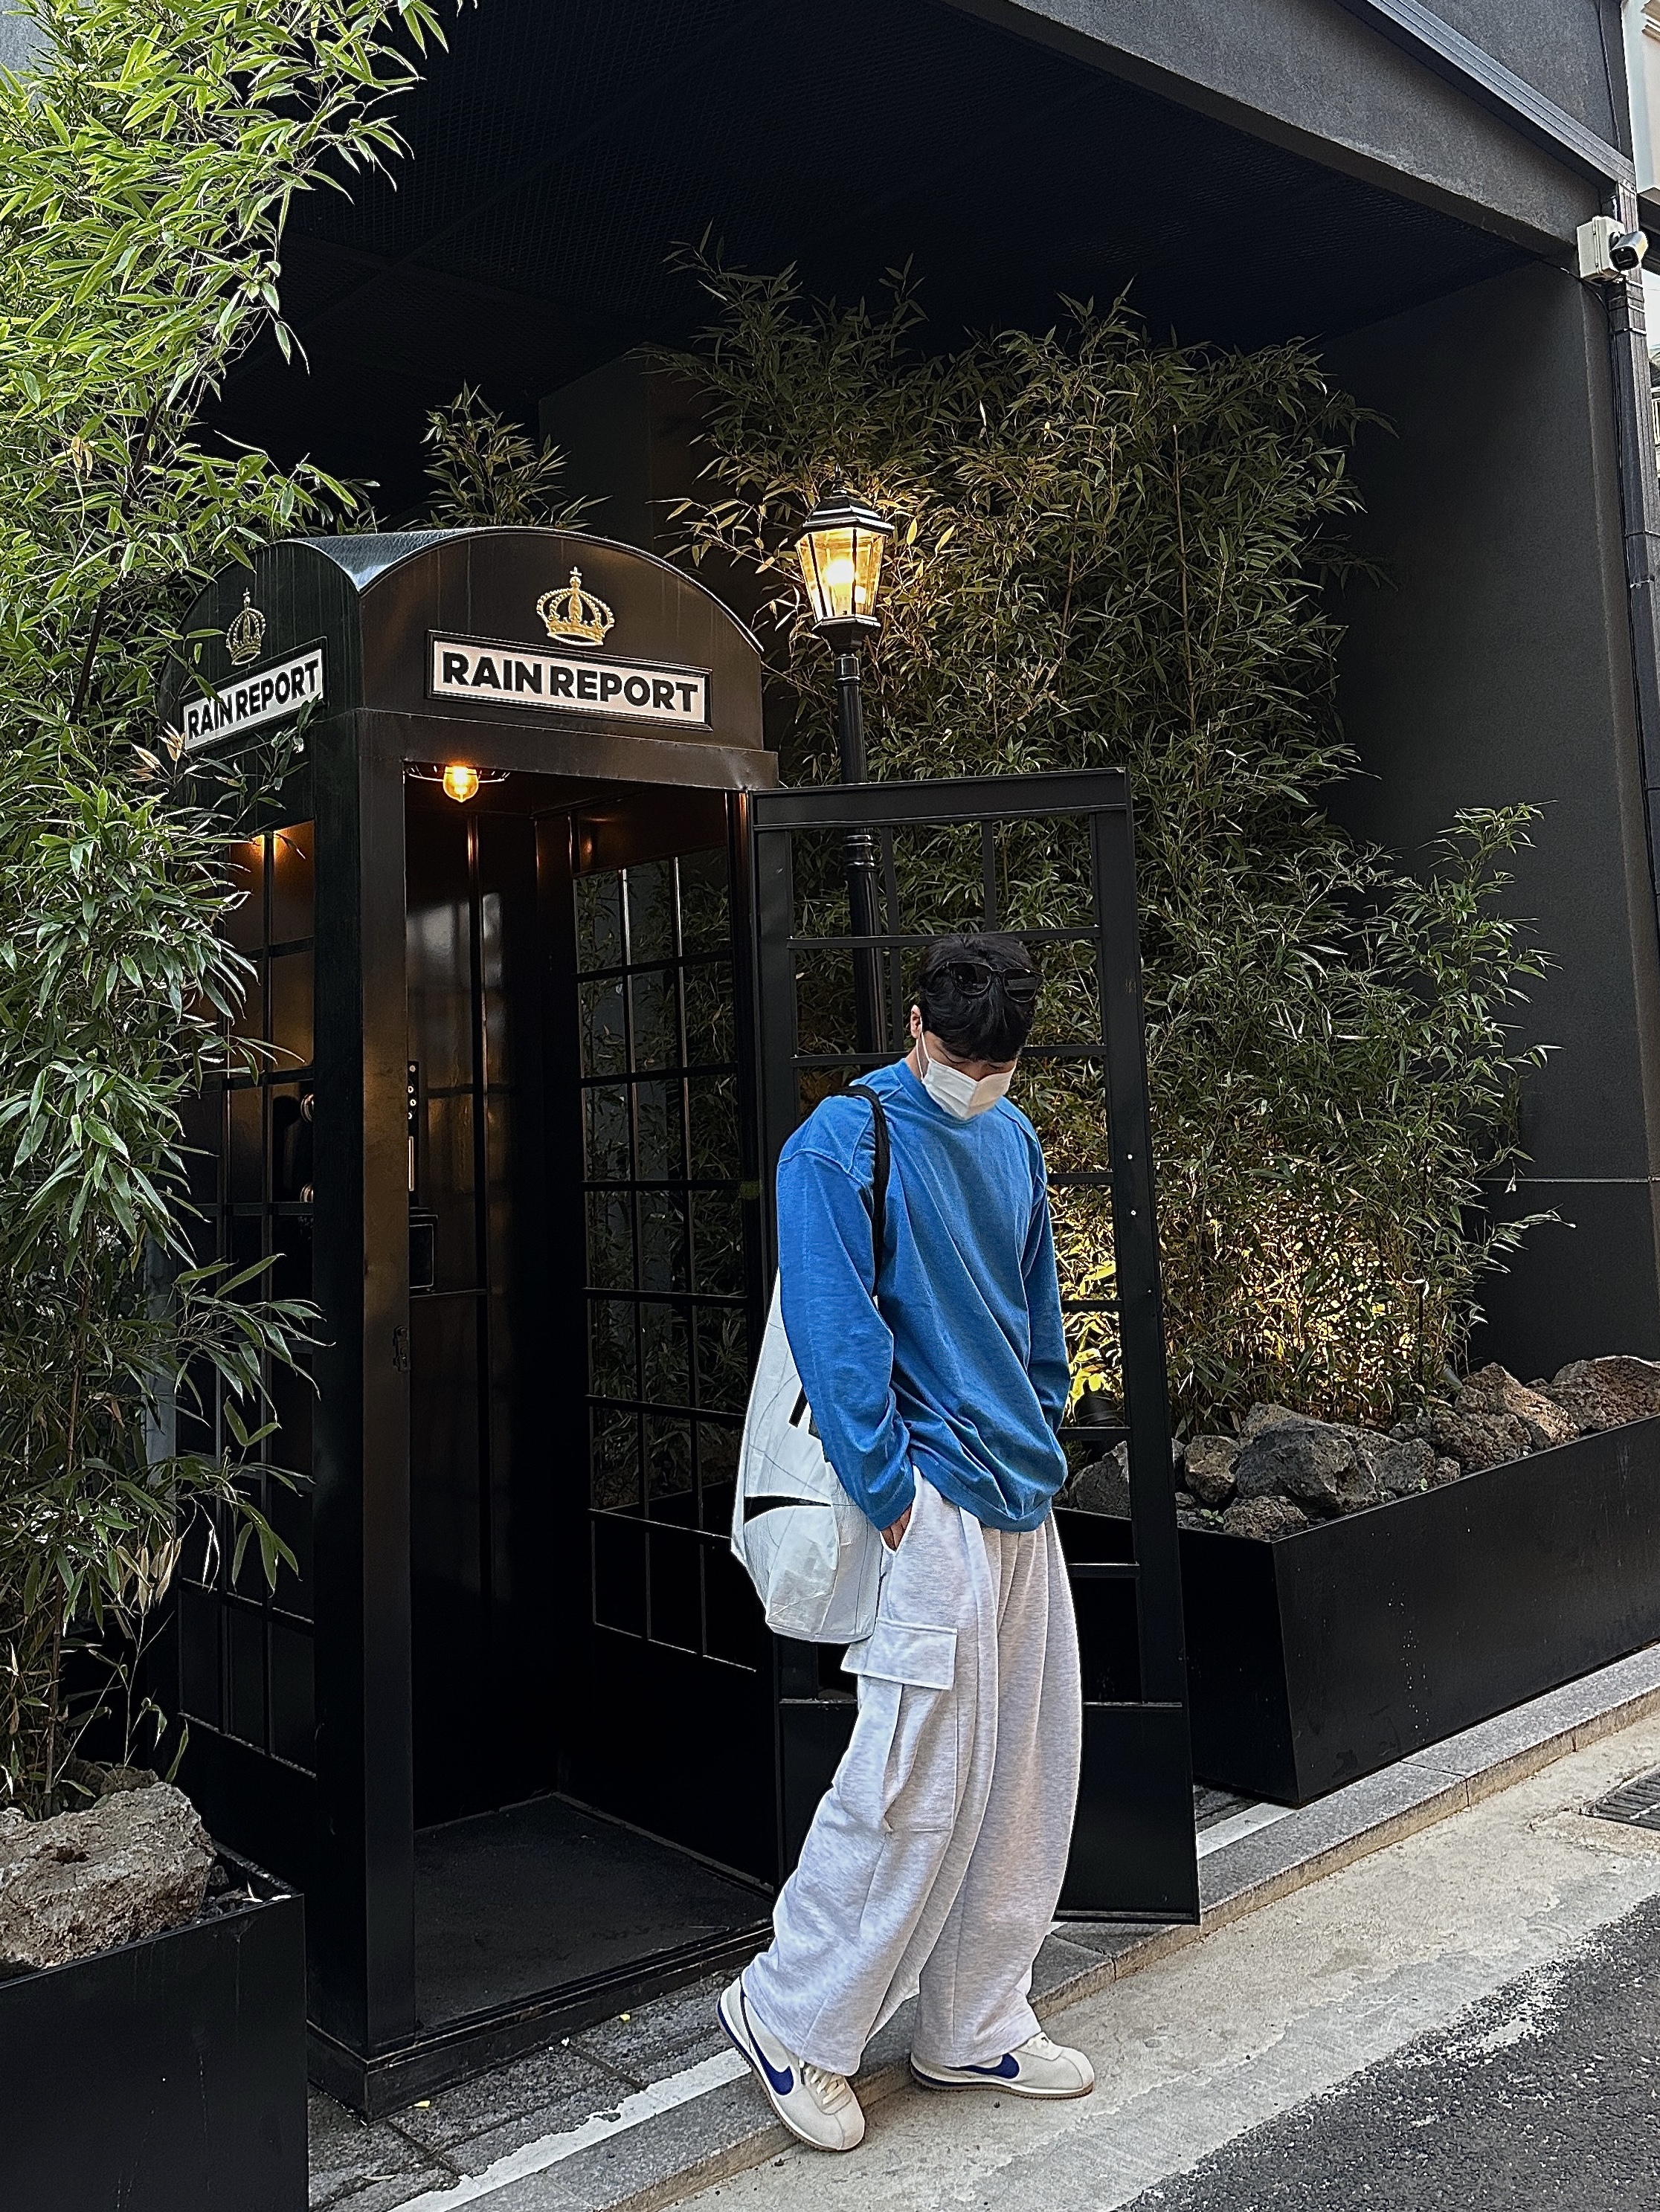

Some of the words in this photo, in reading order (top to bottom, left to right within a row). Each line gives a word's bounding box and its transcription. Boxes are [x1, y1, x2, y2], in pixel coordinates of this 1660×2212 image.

[187, 693, 234, 741] RAIN
[235, 657, 319, 722] REPORT
[443, 651, 543, 694] RAIN
[549, 665, 698, 713] REPORT
